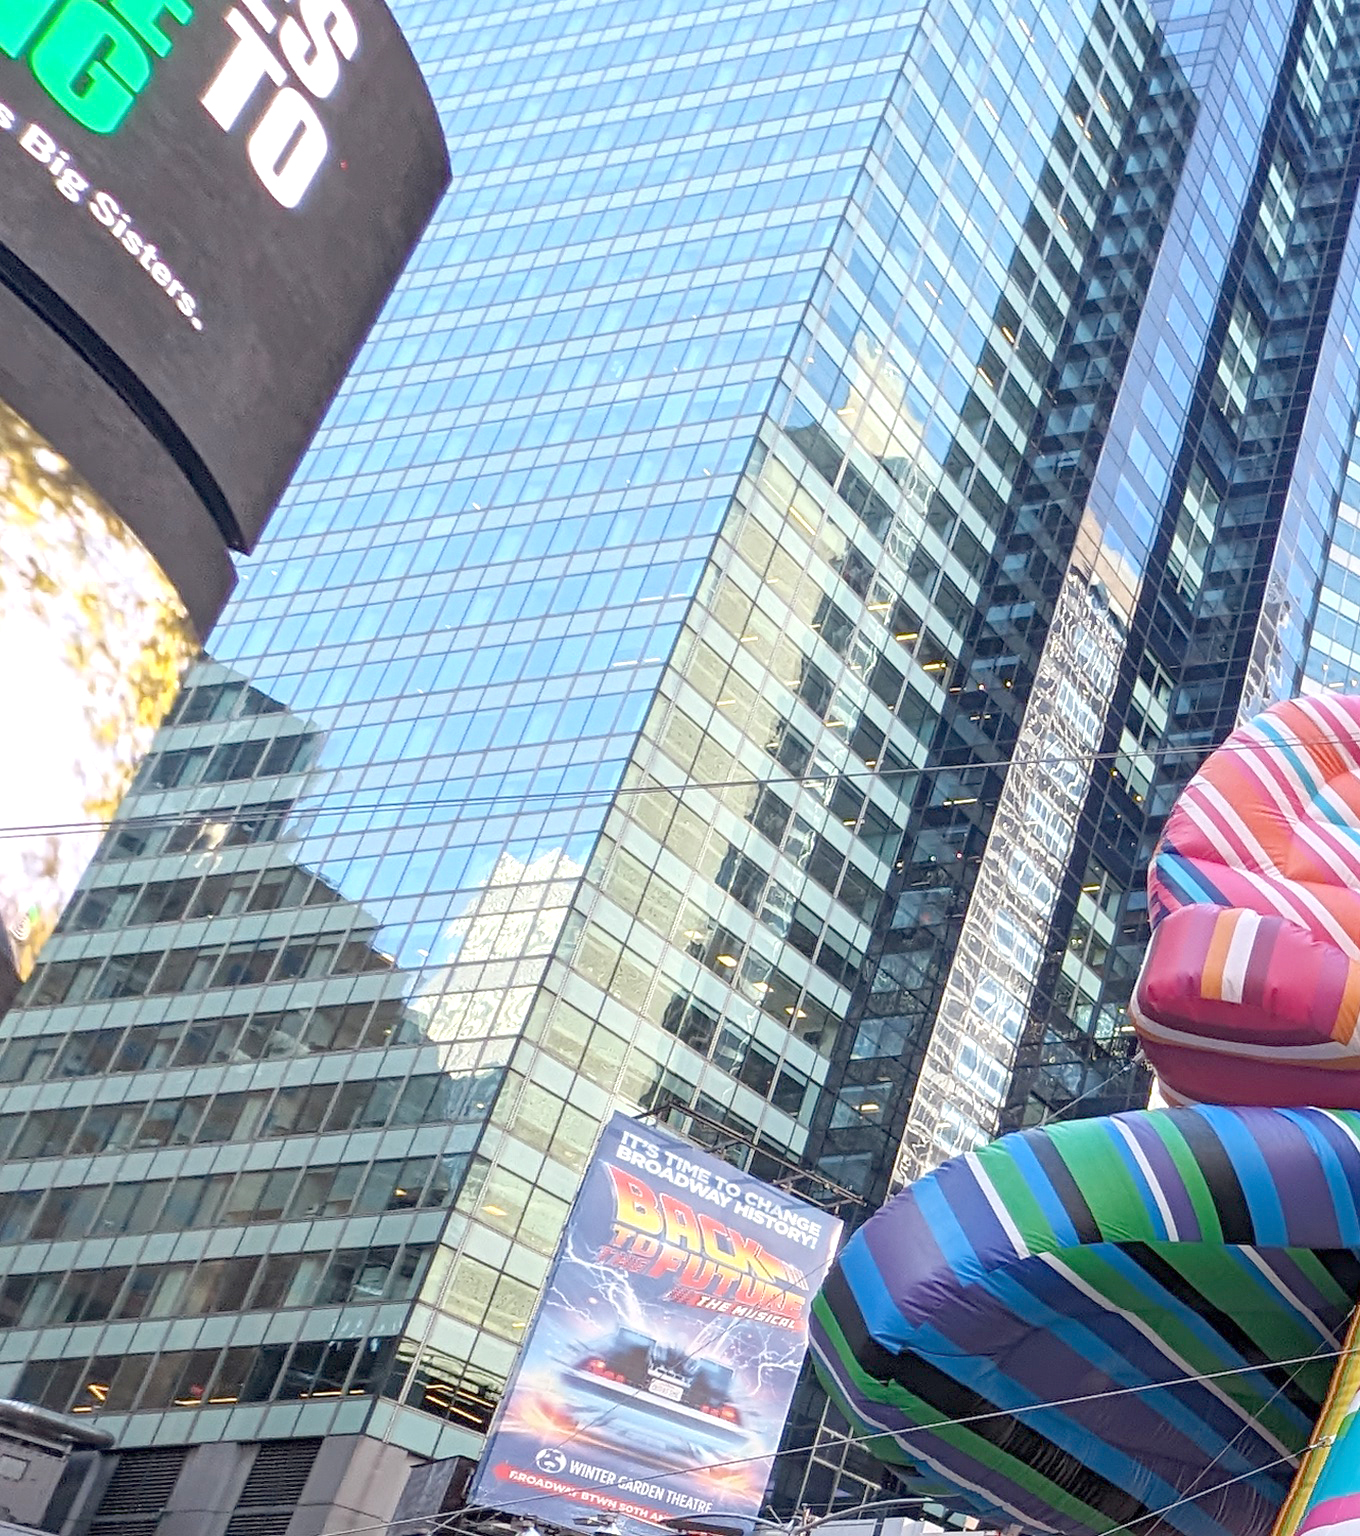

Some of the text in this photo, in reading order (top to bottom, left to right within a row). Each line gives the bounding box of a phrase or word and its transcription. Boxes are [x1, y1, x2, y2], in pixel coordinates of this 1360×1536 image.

[199, 6, 329, 209] TO
[18, 122, 89, 204] Big
[88, 190, 204, 332] Sisters.
[606, 1161, 810, 1292] BACK
[615, 1144, 819, 1251] BROADWAY HISTORY!
[621, 1130, 823, 1237] IT'S TIME TO CHANGE
[610, 1223, 660, 1256] TO
[649, 1244, 807, 1321] FUTURE
[696, 1295, 797, 1331] THE MUSICAL
[508, 1470, 579, 1499] BROADWAY
[580, 1491, 618, 1511] BTWN
[618, 1502, 649, 1519] 50TH
[568, 1458, 713, 1515] WINTER GARDEN THEATRE
